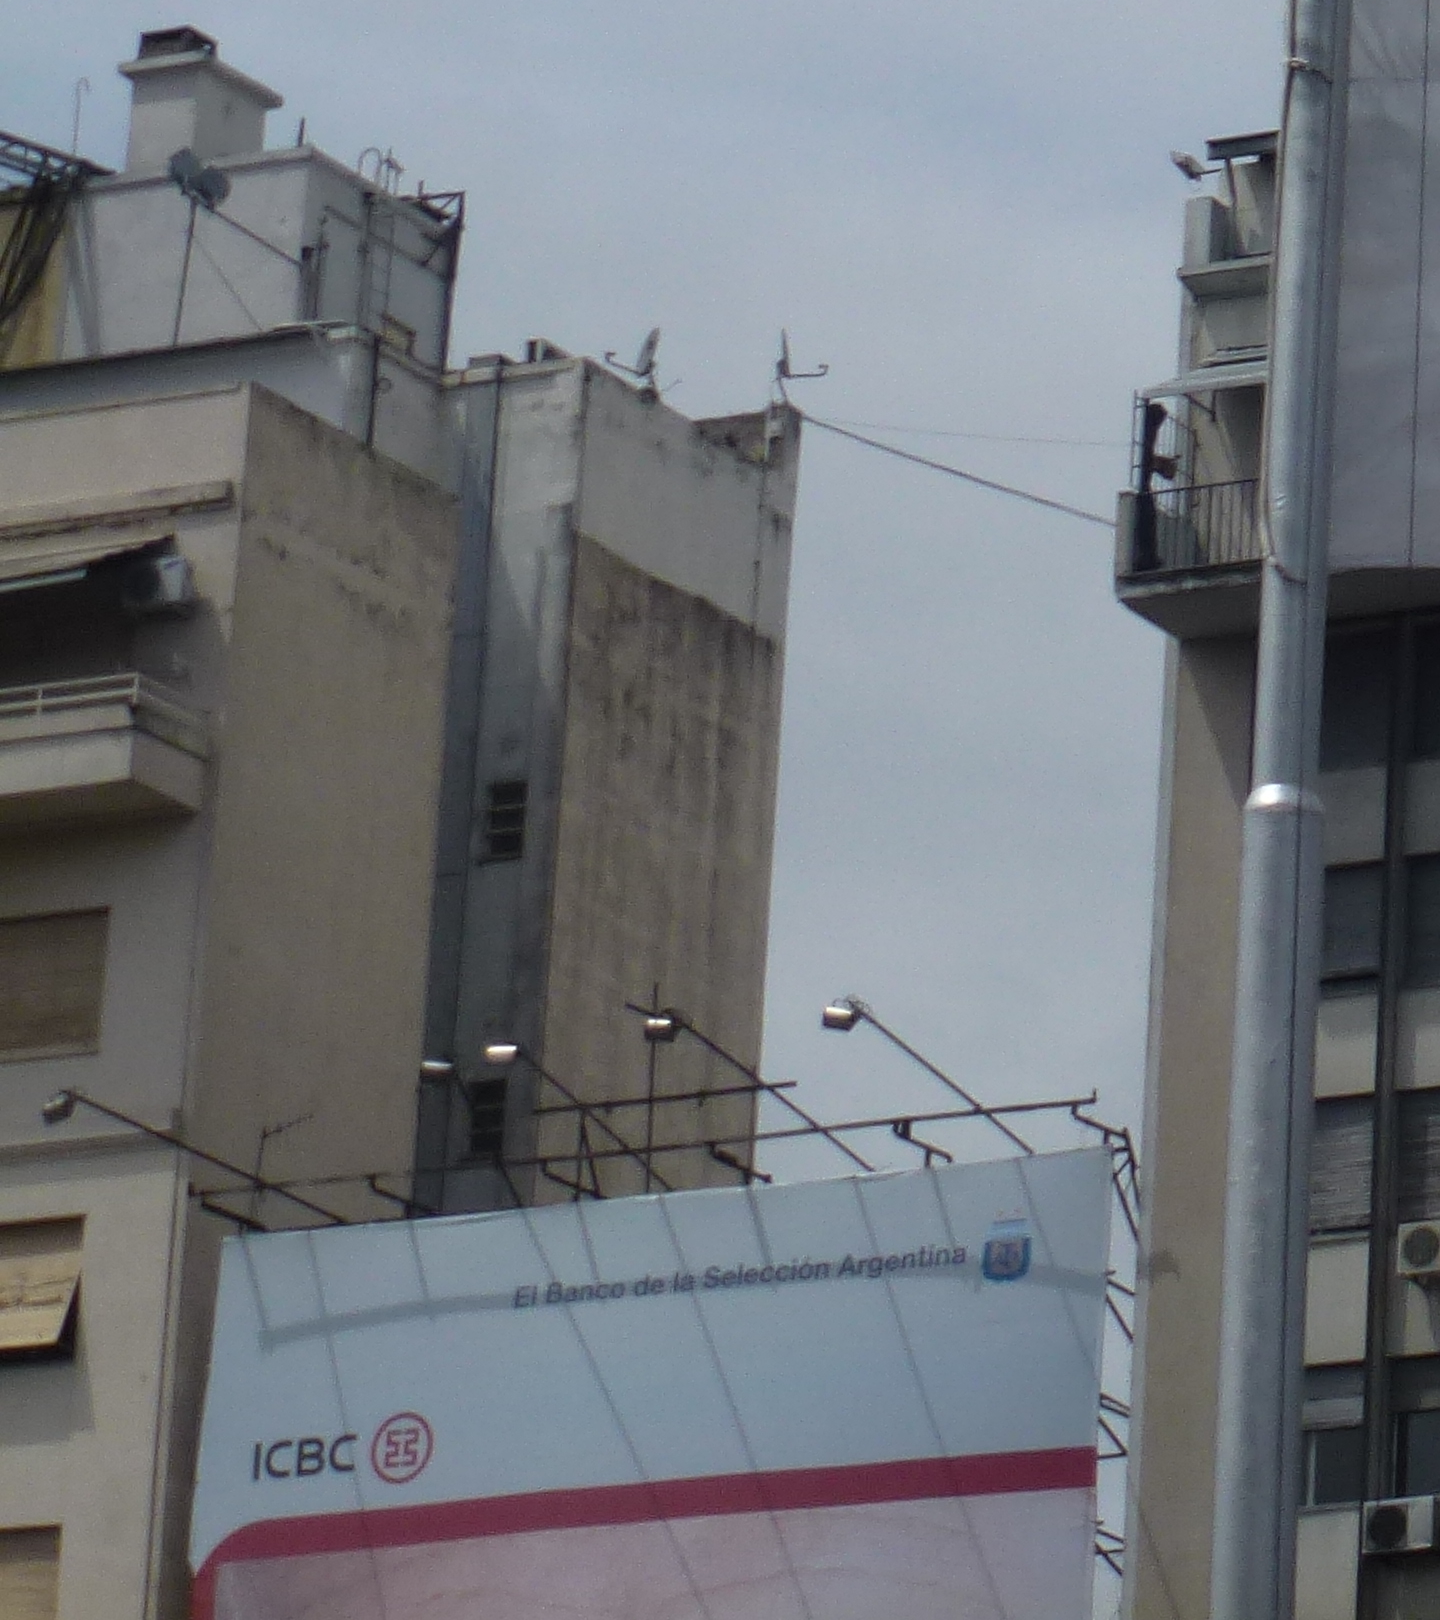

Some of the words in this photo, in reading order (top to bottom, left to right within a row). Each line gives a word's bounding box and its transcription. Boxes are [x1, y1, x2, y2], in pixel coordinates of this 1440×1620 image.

[514, 1284, 537, 1308] El
[547, 1281, 626, 1304] Banco
[634, 1274, 665, 1297] de
[673, 1272, 695, 1293] la
[703, 1256, 831, 1289] Selección
[838, 1244, 966, 1278] Argentina
[253, 1434, 358, 1481] ICBC
